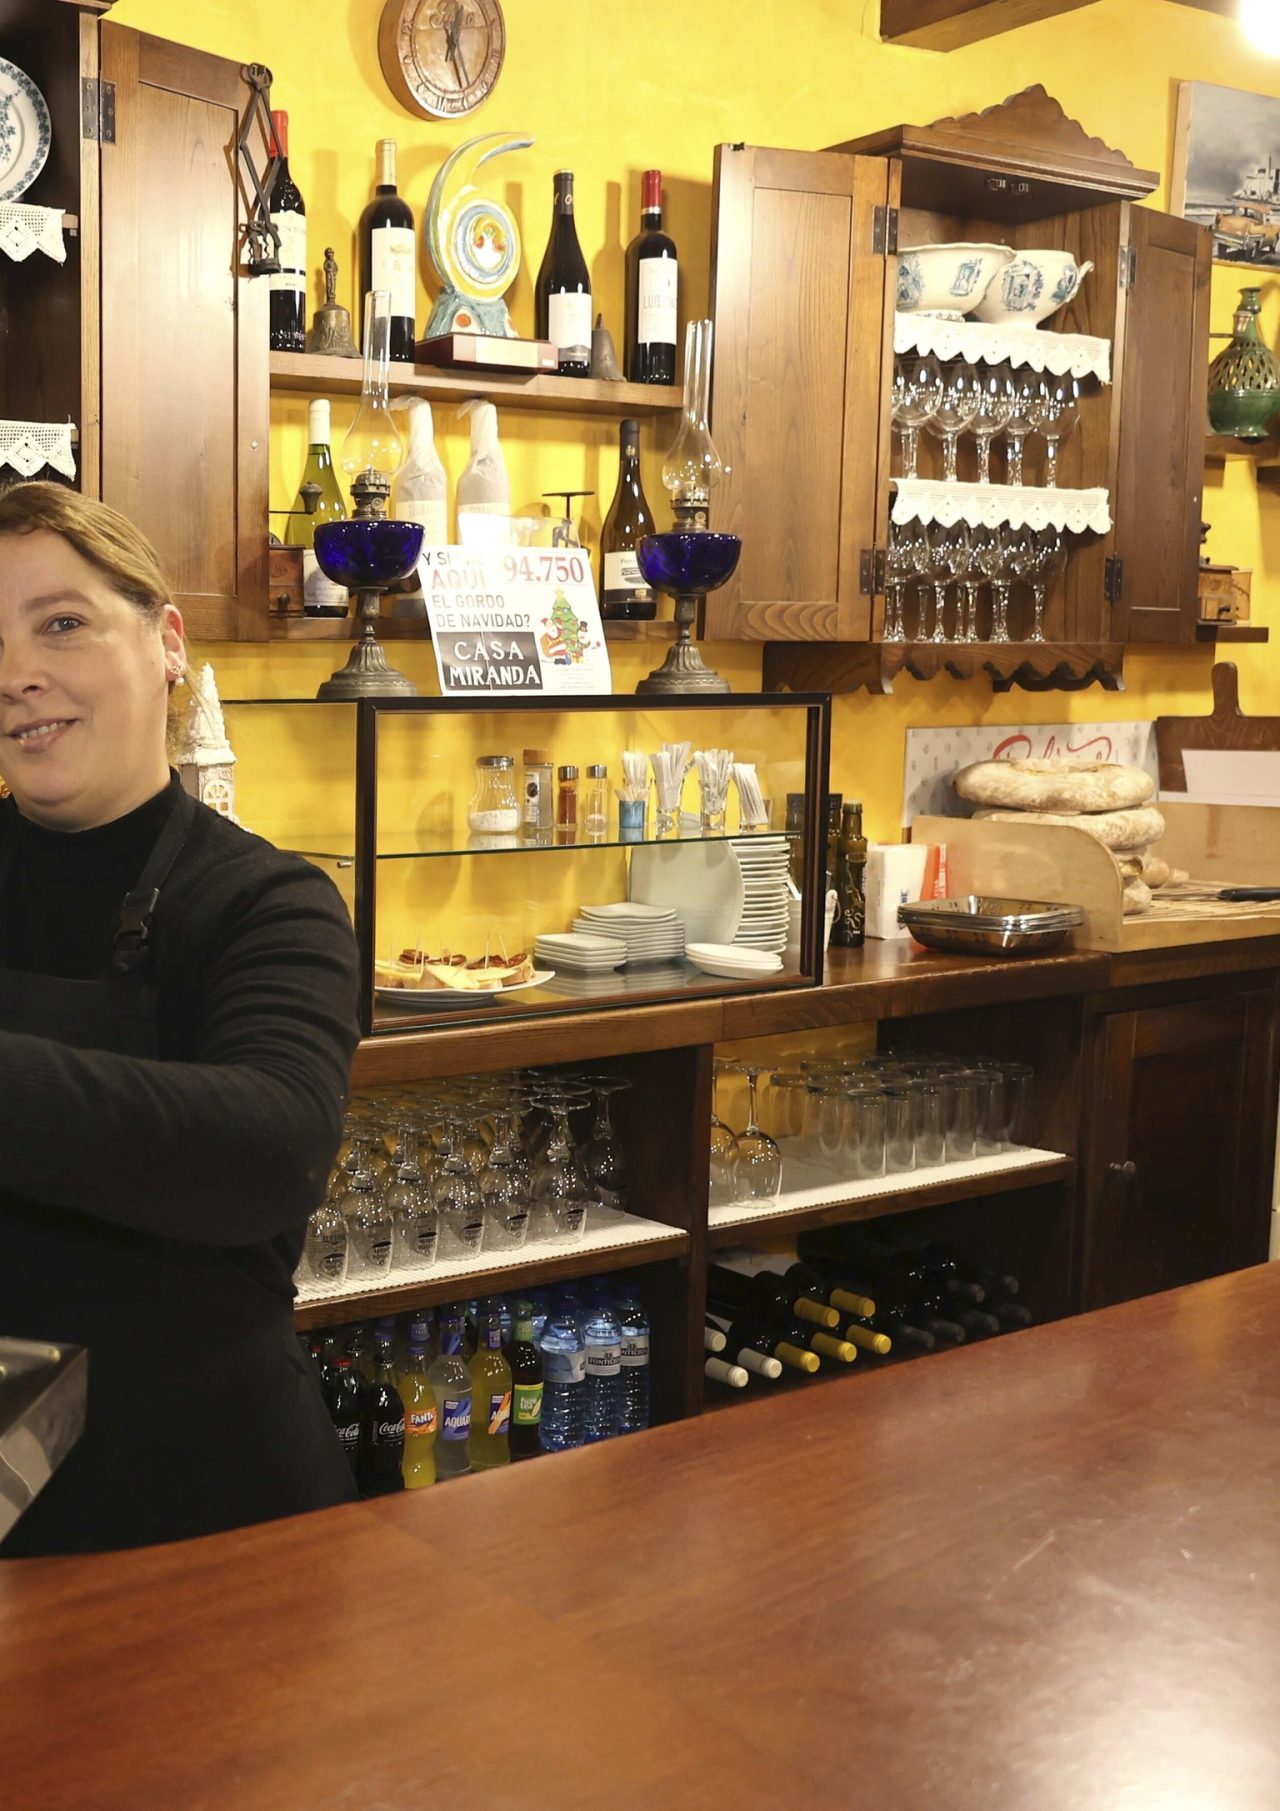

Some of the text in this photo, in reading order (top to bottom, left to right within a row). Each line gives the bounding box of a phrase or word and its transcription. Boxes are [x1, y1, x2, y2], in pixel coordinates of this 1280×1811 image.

[422, 552, 431, 566] Y
[503, 554, 584, 583] 94.750
[432, 594, 505, 609] EL GORDO
[436, 613, 530, 628] DE NAVIDAD?
[454, 640, 524, 661] CASA
[449, 664, 541, 687] MIRANDA
[444, 1413, 471, 1428] AQUAR
